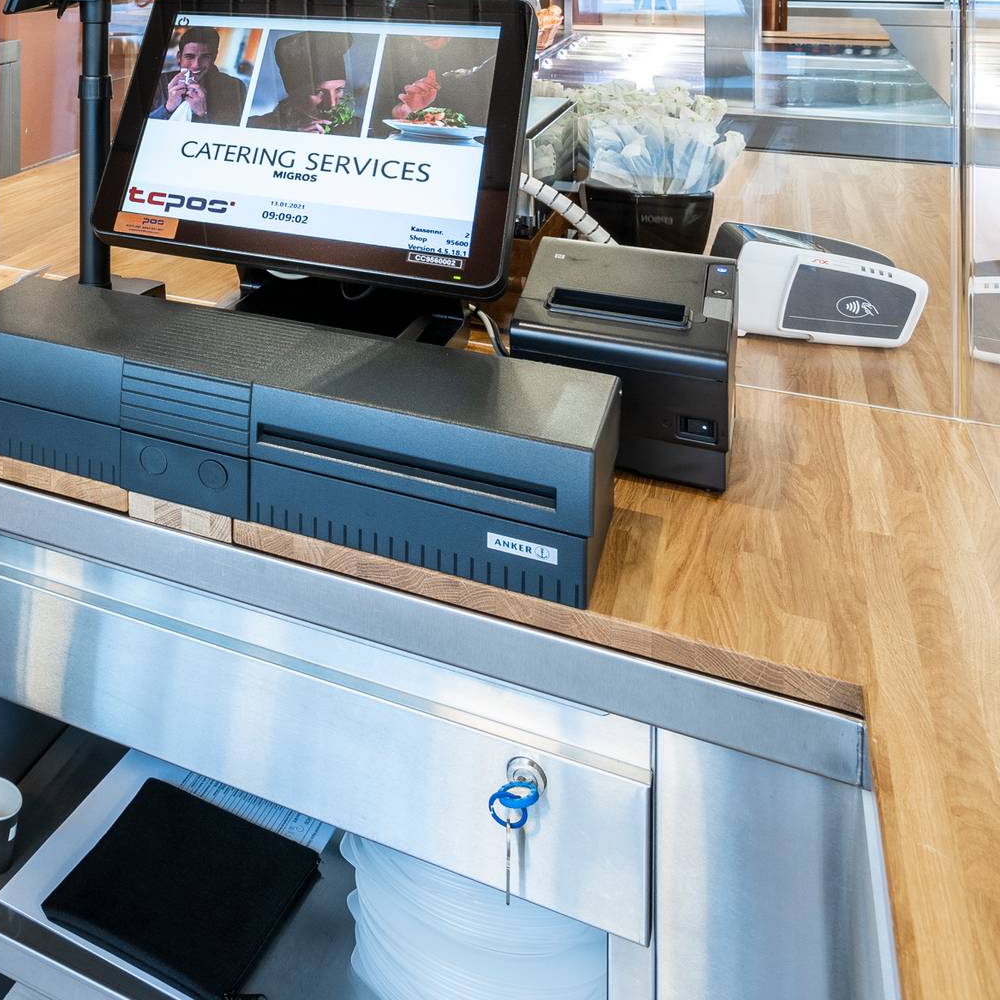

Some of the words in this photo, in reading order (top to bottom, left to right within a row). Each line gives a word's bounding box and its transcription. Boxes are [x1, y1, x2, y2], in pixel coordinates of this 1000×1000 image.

[181, 140, 296, 169] CATERING
[305, 152, 431, 183] SERVICES
[272, 170, 318, 183] MIGROS
[271, 200, 306, 210] 13.01.2021
[261, 210, 309, 225] 09:09:02
[410, 226, 444, 236] Kassennr.
[409, 235, 428, 243] Shop
[446, 239, 469, 247] 95600
[408, 244, 435, 253] Version
[437, 248, 467, 257] 4.5.18.1
[414, 254, 457, 267] CC9560002
[494, 538, 532, 554] ANKER
